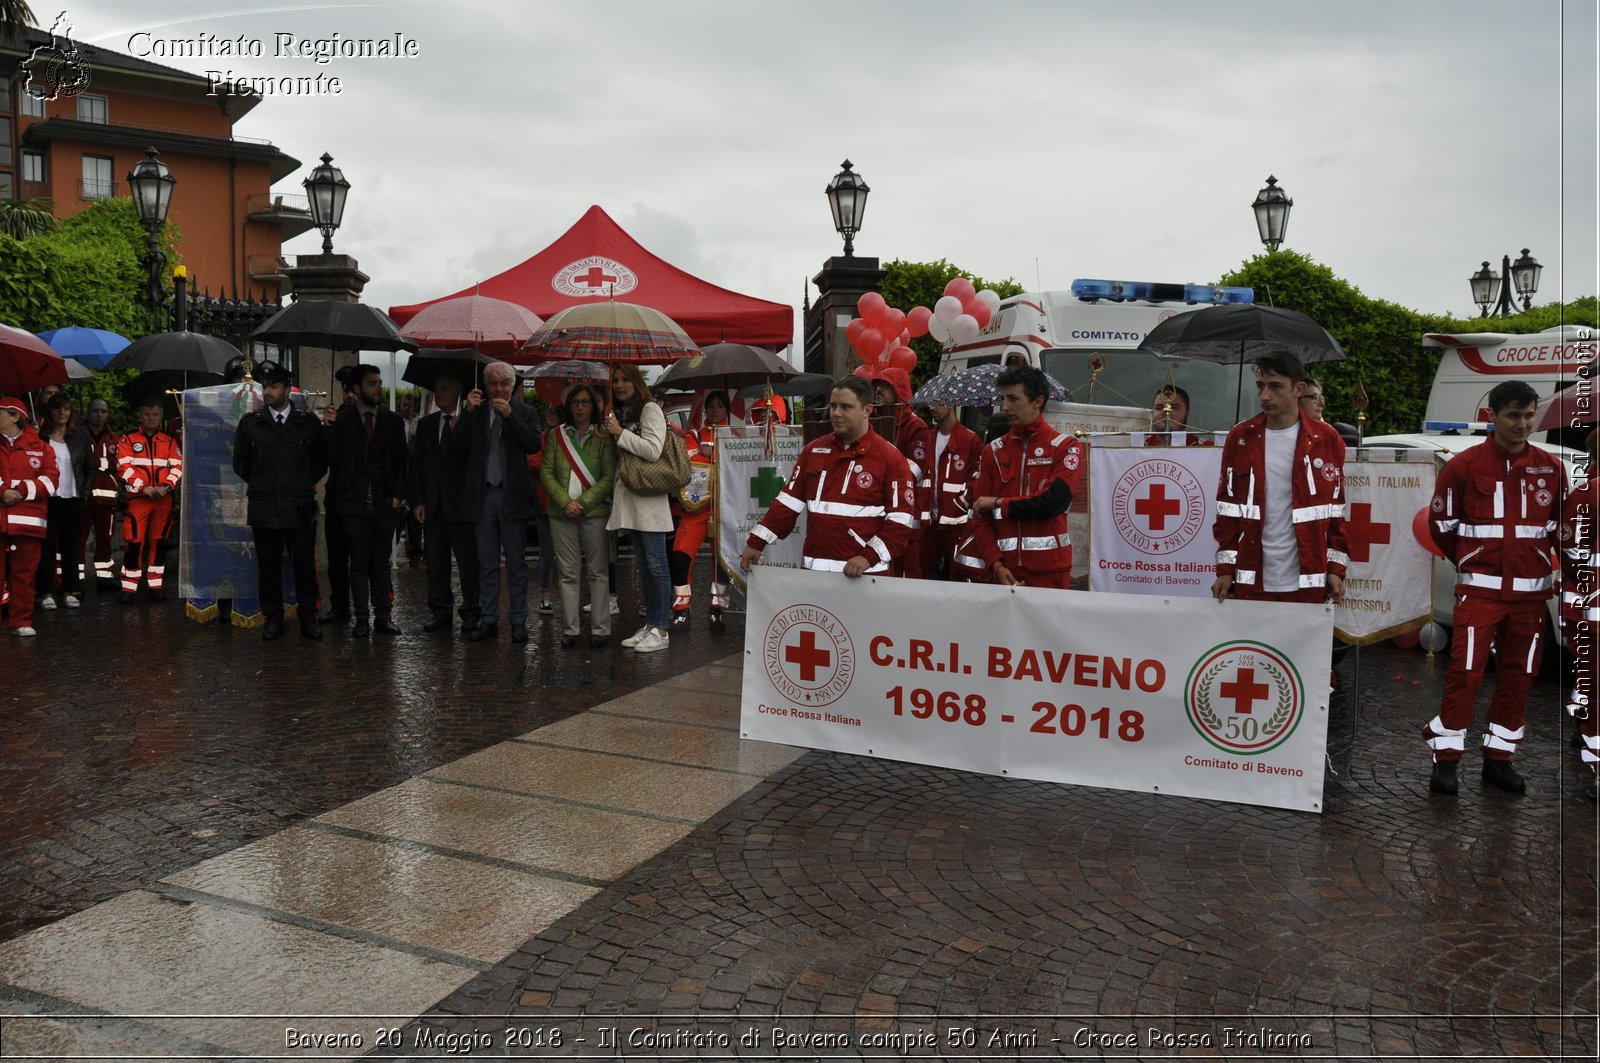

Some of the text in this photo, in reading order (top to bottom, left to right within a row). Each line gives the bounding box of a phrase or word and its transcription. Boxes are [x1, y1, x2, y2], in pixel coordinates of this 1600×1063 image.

[1071, 330, 1139, 341] COMITATO
[1496, 346, 1551, 362] CROCE
[731, 455, 762, 463] PUBBLICA
[1377, 476, 1421, 489] ITALIANA
[1115, 463, 1202, 551] CONVENZIONE DI GINEVRA 22 AGOSTO 1864
[1099, 559, 1217, 573] Croce Rossa Italiana
[1115, 573, 1201, 585] Comitato di Baveno
[767, 608, 852, 702] CONVENZIONE DI GINEVRA 22 AGOSTO 1864
[868, 635, 1166, 693] C.R.I. BAVENO
[758, 704, 861, 726] Croce Rossa Italiana
[886, 685, 1145, 742] 1968 - 2018
[1224, 716, 1259, 741] 50
[1184, 755, 1304, 777] Comitato di Baveno
